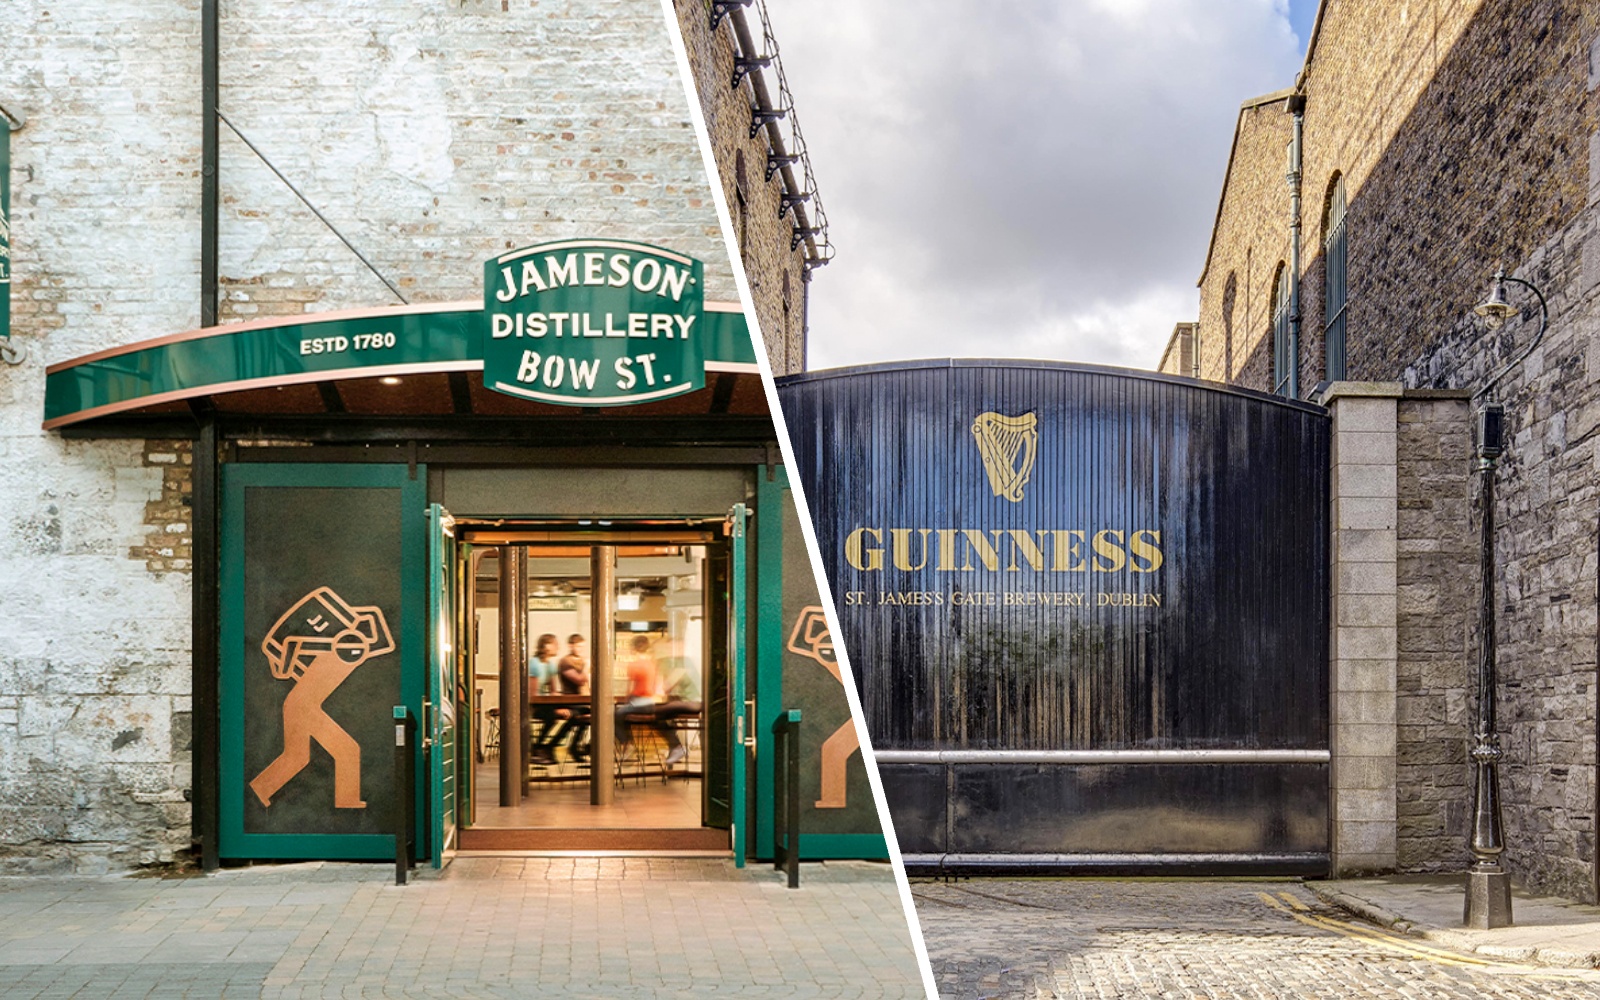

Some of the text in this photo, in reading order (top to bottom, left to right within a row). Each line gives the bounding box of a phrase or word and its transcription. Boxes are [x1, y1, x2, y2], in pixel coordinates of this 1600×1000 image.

[492, 312, 696, 339] DISTILLERY
[300, 332, 396, 355] ESTD 1780
[517, 350, 672, 390] BOW ST.
[845, 527, 1163, 573] GUINNESS
[845, 591, 1162, 609] ST. JAMES'S GATE BREWERY, DUBLIN
